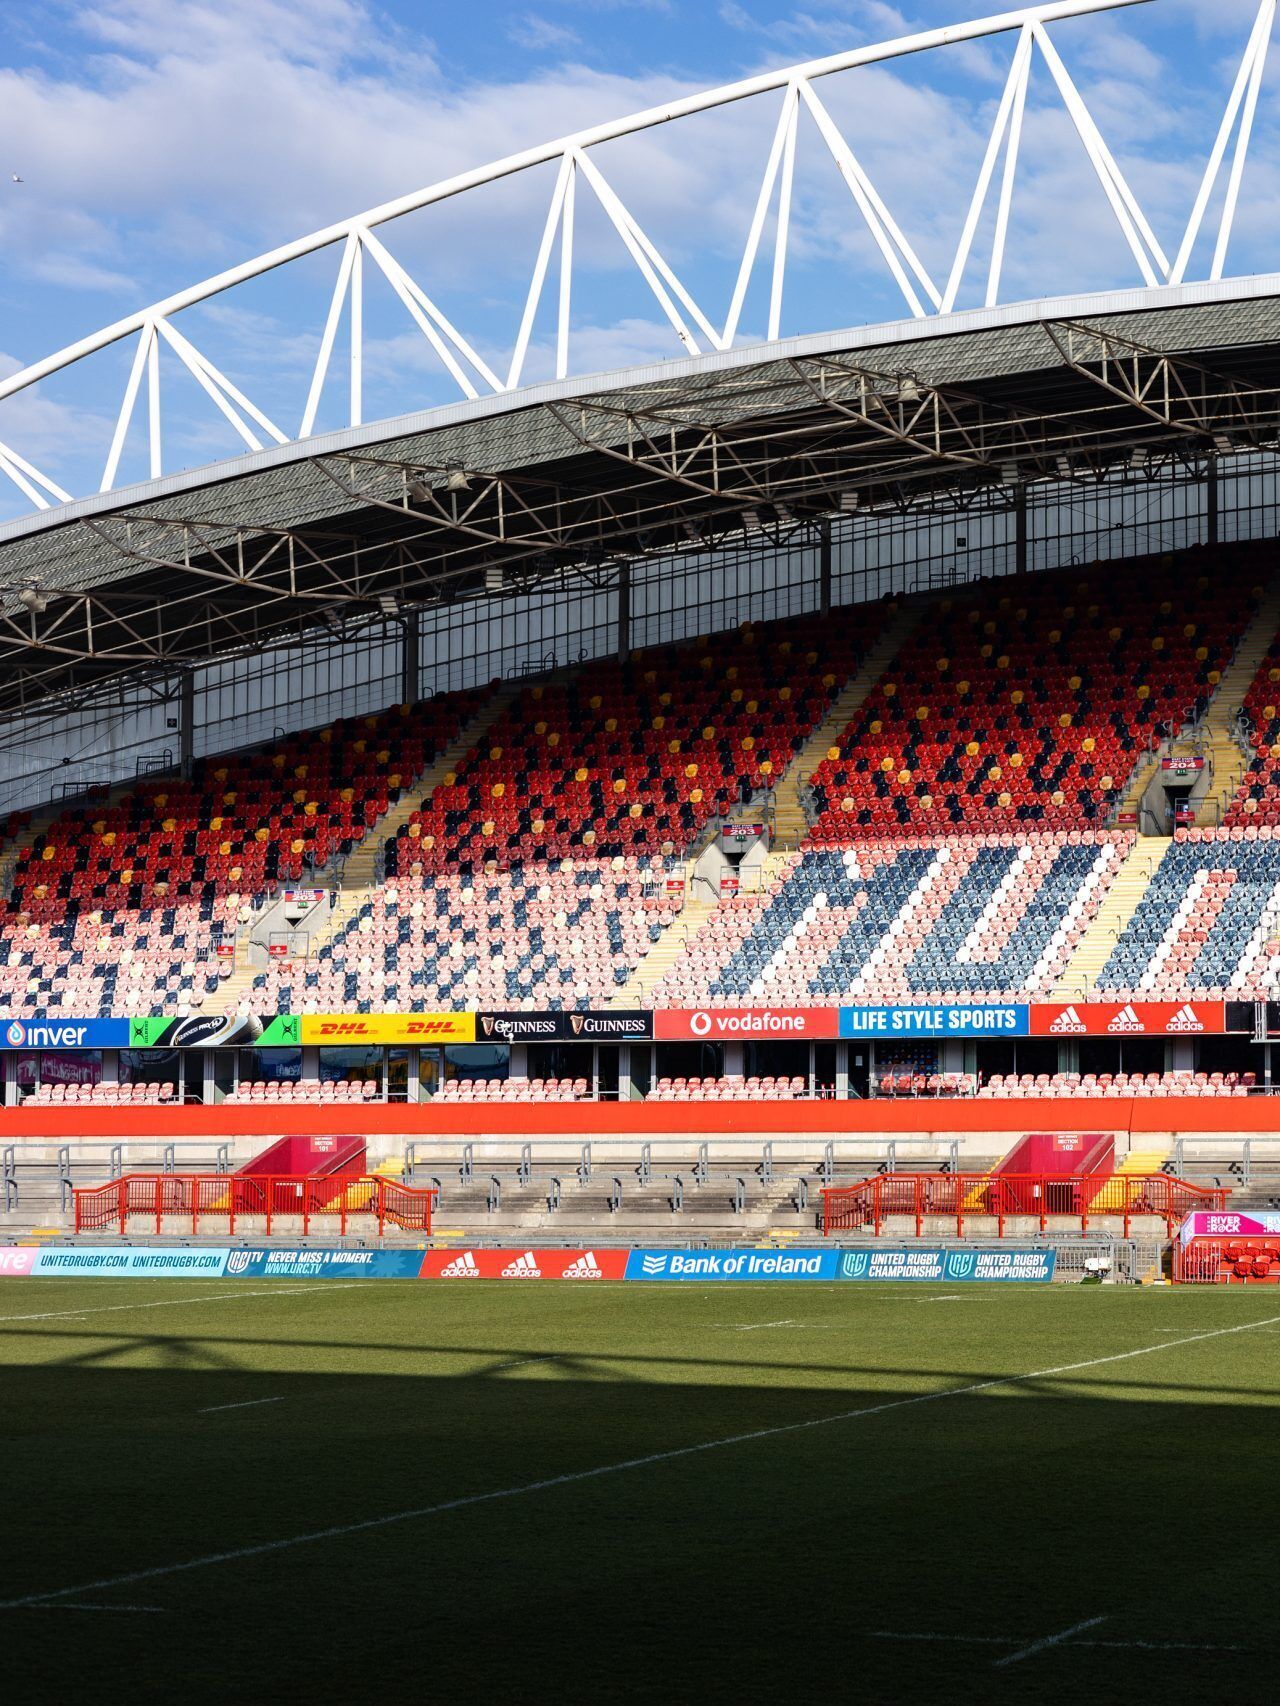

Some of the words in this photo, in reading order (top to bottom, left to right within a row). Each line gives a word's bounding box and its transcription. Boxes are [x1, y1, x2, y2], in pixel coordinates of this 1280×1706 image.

[584, 1018, 646, 1032] GUINNESS
[717, 1012, 805, 1031] vodafone
[853, 1010, 886, 1030] LIFE
[892, 1010, 943, 1030] STYLE
[948, 1009, 1016, 1028] SPORTS
[320, 1023, 369, 1035] DHL
[406, 1022, 456, 1034] DHL
[1050, 1022, 1086, 1032] adidas
[1108, 1022, 1144, 1032] adidas
[1166, 1022, 1204, 1032] adidas
[28, 1026, 87, 1046] inver
[1210, 1216, 1240, 1224] RIVER
[1210, 1224, 1240, 1232] ROCK
[0, 1252, 28, 1270] re
[40, 1255, 130, 1267] UNITEDRUGBY.COM
[132, 1256, 222, 1268] UNITEDRUGBY.COM
[250, 1252, 264, 1262] TV
[268, 1252, 296, 1262] NEVER
[299, 1252, 322, 1262] MISS
[322, 1252, 330, 1263] A
[331, 1252, 373, 1264] MOMENT.
[871, 1254, 905, 1265] UNITED
[907, 1254, 940, 1266] RUGBY
[977, 1254, 1010, 1266] UNITED
[1013, 1254, 1046, 1266] RUGBY
[264, 1264, 322, 1274] WWW.URC.TV
[670, 1256, 722, 1274] Bank
[724, 1255, 748, 1273] of
[748, 1256, 822, 1273] Ireland
[440, 1267, 480, 1277] adidas
[501, 1267, 541, 1278] adidas
[562, 1268, 602, 1278] adidas
[869, 1266, 942, 1278] CHAMPIONSHIP
[974, 1266, 1048, 1278] CHAMPIONSHIP
